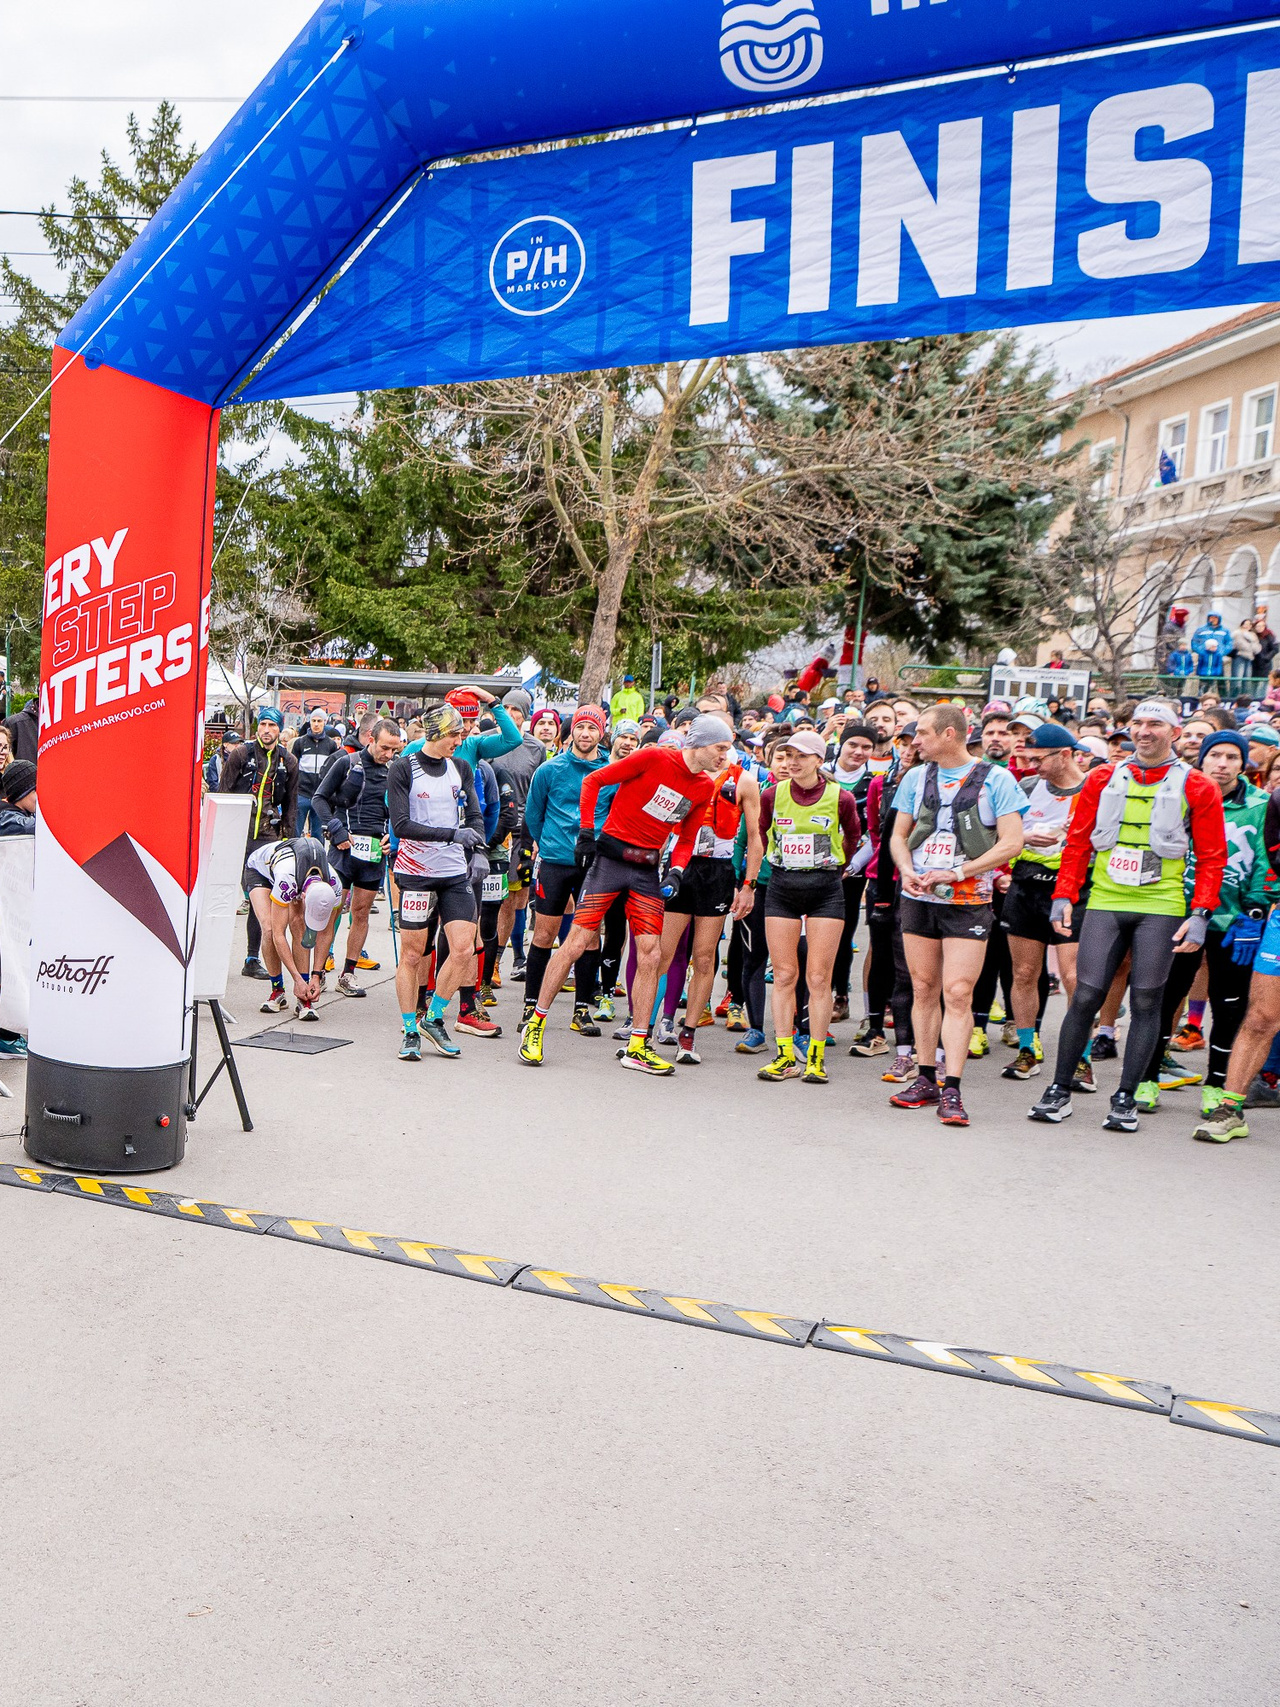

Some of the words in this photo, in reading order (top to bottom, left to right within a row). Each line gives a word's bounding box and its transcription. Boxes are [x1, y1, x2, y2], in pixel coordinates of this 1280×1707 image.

[530, 236, 543, 245] IN
[506, 244, 568, 281] P/H
[506, 279, 567, 294] MARKOVO
[42, 527, 129, 624] ERY
[53, 571, 177, 667] STEP
[38, 622, 193, 737] ATTERS
[653, 794, 676, 812] 4292
[353, 842, 370, 852] 223
[783, 844, 811, 855] 4262
[924, 844, 952, 856] 4275
[1110, 857, 1139, 872] 4280
[403, 899, 428, 911] 4289
[42, 981, 74, 994] STUDIO
